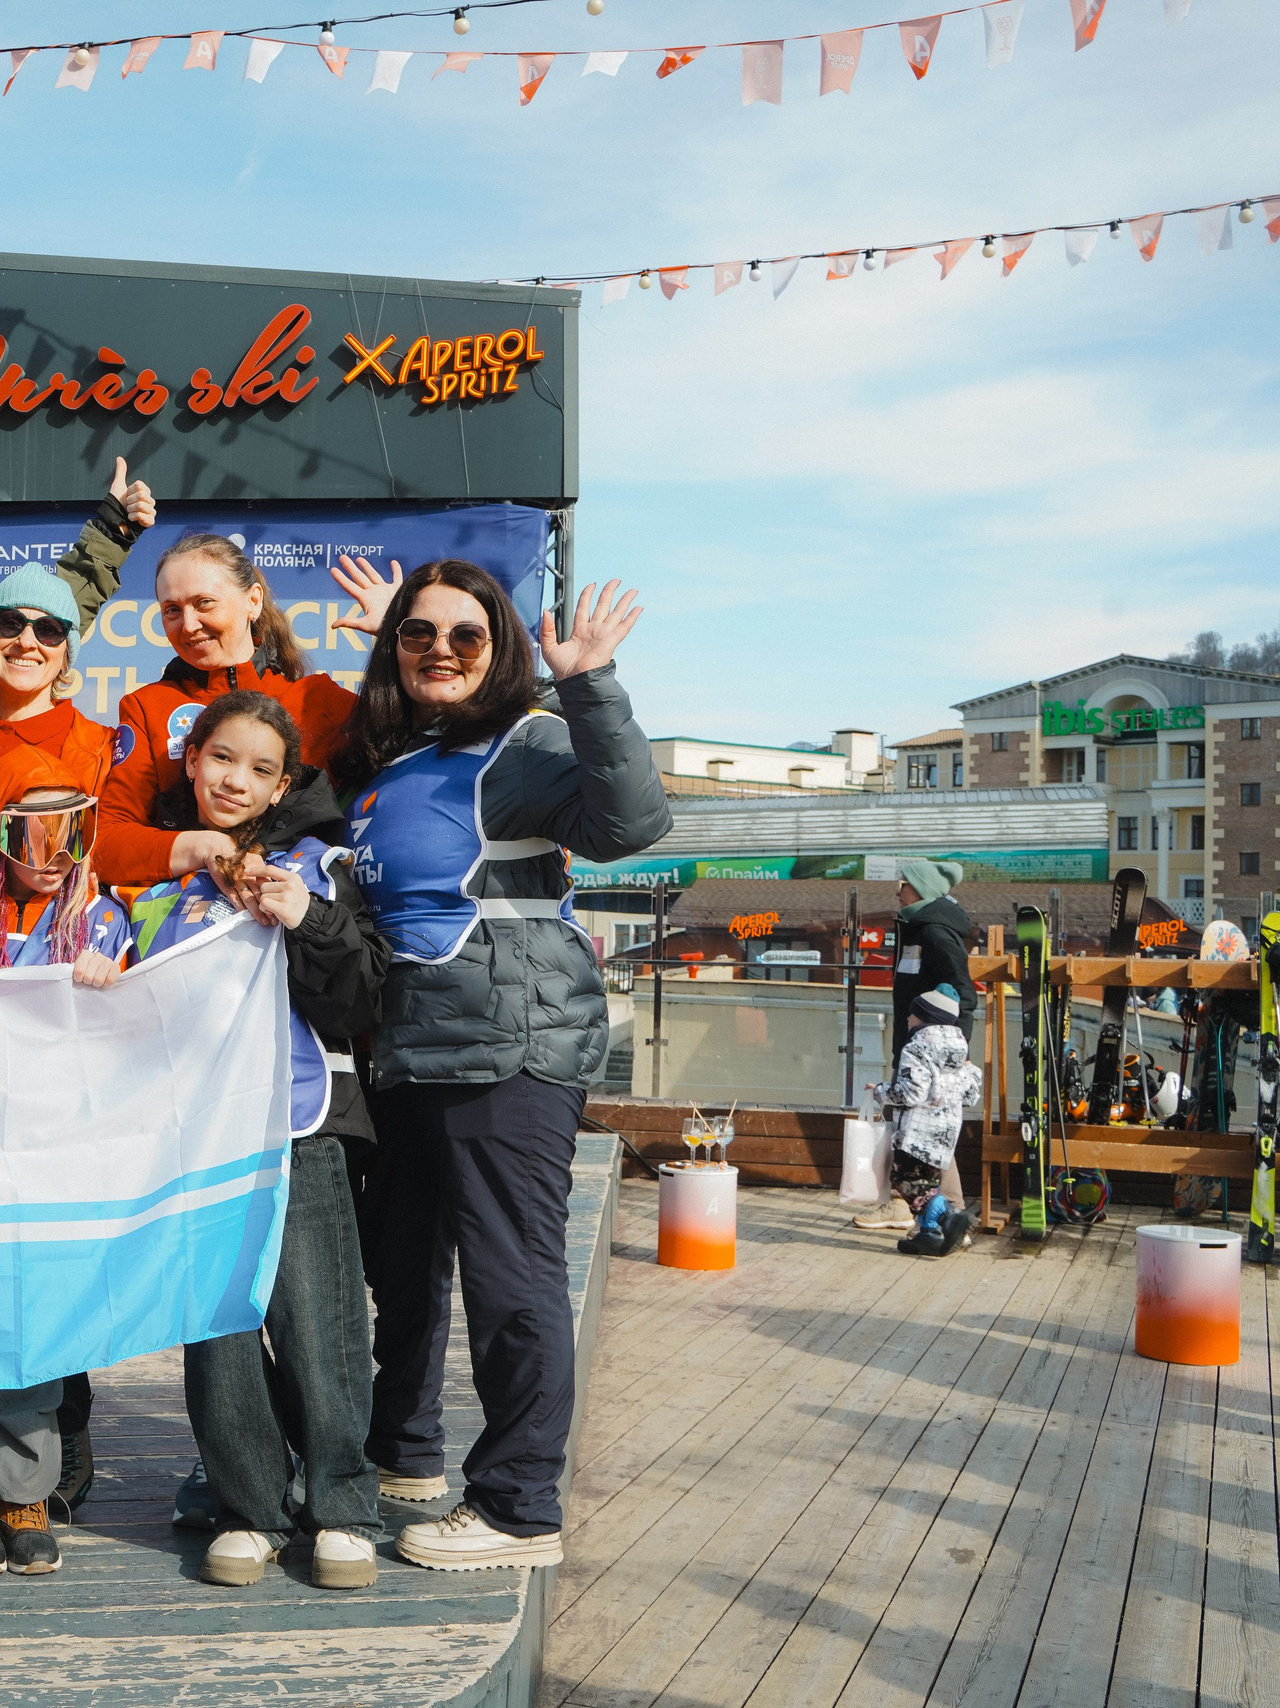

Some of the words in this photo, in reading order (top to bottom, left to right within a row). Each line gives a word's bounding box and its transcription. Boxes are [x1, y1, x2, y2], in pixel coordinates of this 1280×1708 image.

[188, 303, 320, 416] ski
[398, 326, 544, 384] APEROL
[254, 544, 323, 555] КРАСНАЯ
[334, 545, 384, 556] КУРОРТ
[253, 556, 316, 567] ПОЛЯНА
[1042, 699, 1105, 736] ibis
[618, 868, 680, 888] ждут!
[728, 911, 781, 933] APEROL
